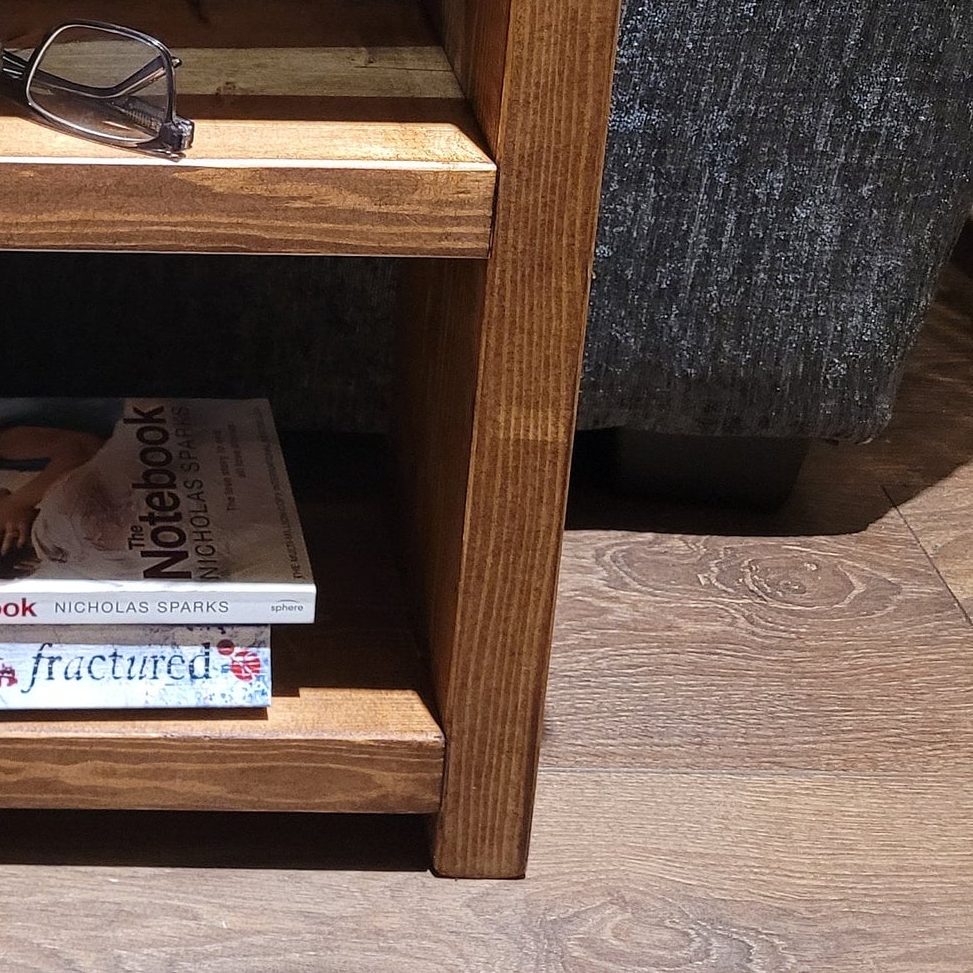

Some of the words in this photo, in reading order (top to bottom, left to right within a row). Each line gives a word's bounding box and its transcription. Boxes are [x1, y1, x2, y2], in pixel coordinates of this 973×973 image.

[171, 405, 201, 473] SPARKS
[123, 405, 192, 579] Notebook
[225, 496, 236, 512] The
[128, 525, 145, 550] The
[183, 478, 219, 579] NICHOLAS
[55, 601, 149, 614] NICHOLAS
[157, 601, 229, 614] SPARKS
[271, 603, 304, 613] sphere
[21, 642, 213, 694] fractured
